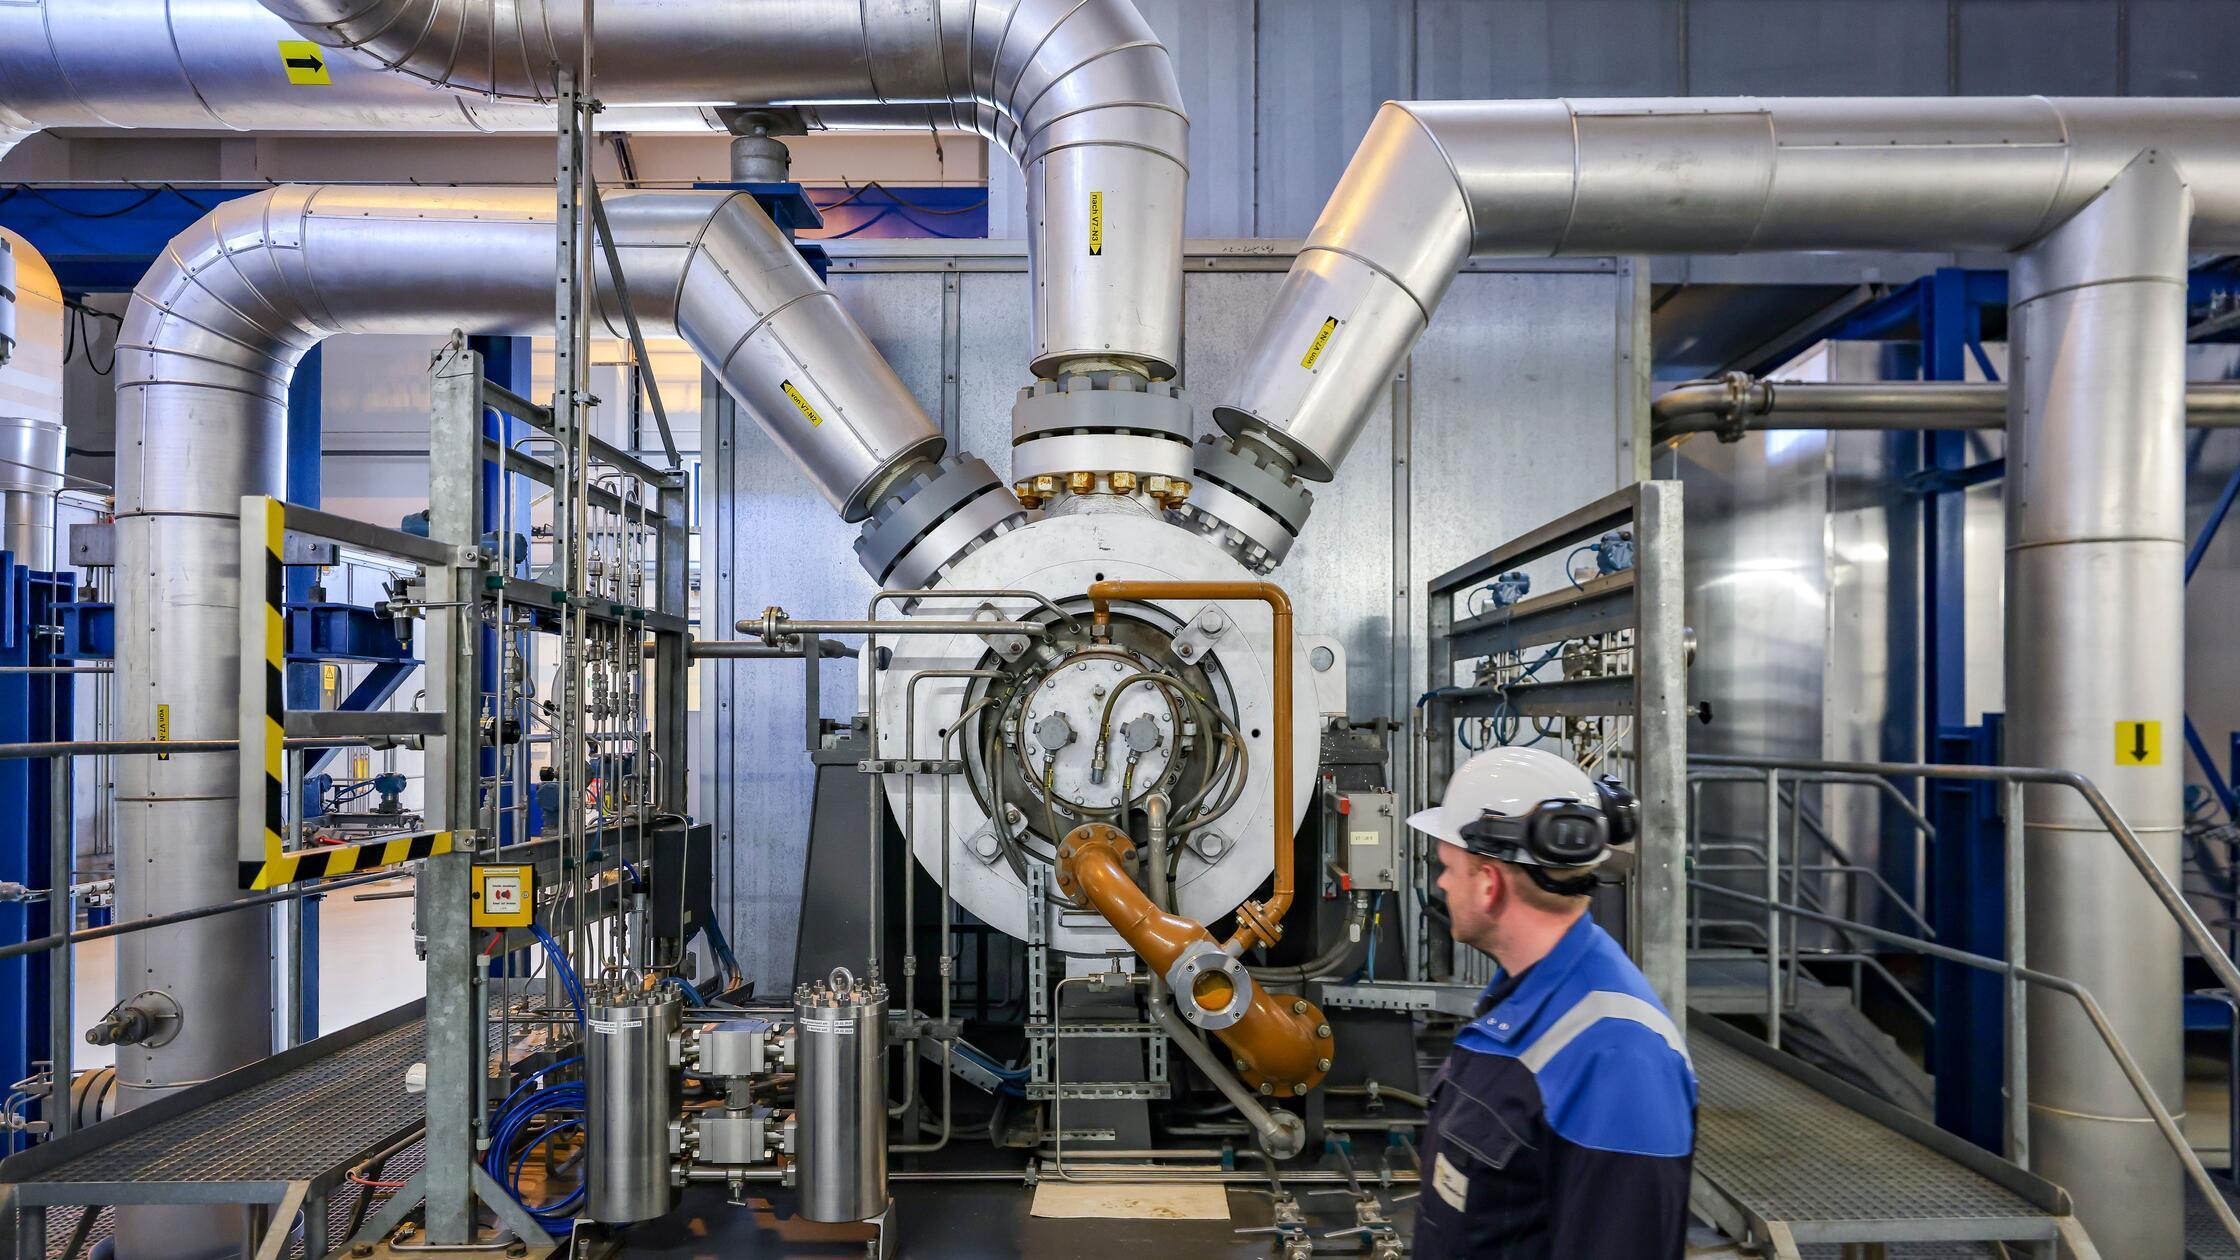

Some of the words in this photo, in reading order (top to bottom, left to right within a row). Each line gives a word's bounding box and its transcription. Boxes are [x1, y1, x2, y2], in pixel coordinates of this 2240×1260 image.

[1091, 194, 1099, 215] nach
[1091, 216, 1099, 242] V7-N3
[1306, 352, 1317, 364] von
[1313, 330, 1329, 351] V7-N4
[791, 392, 801, 405] von
[800, 403, 817, 423] V7-N2
